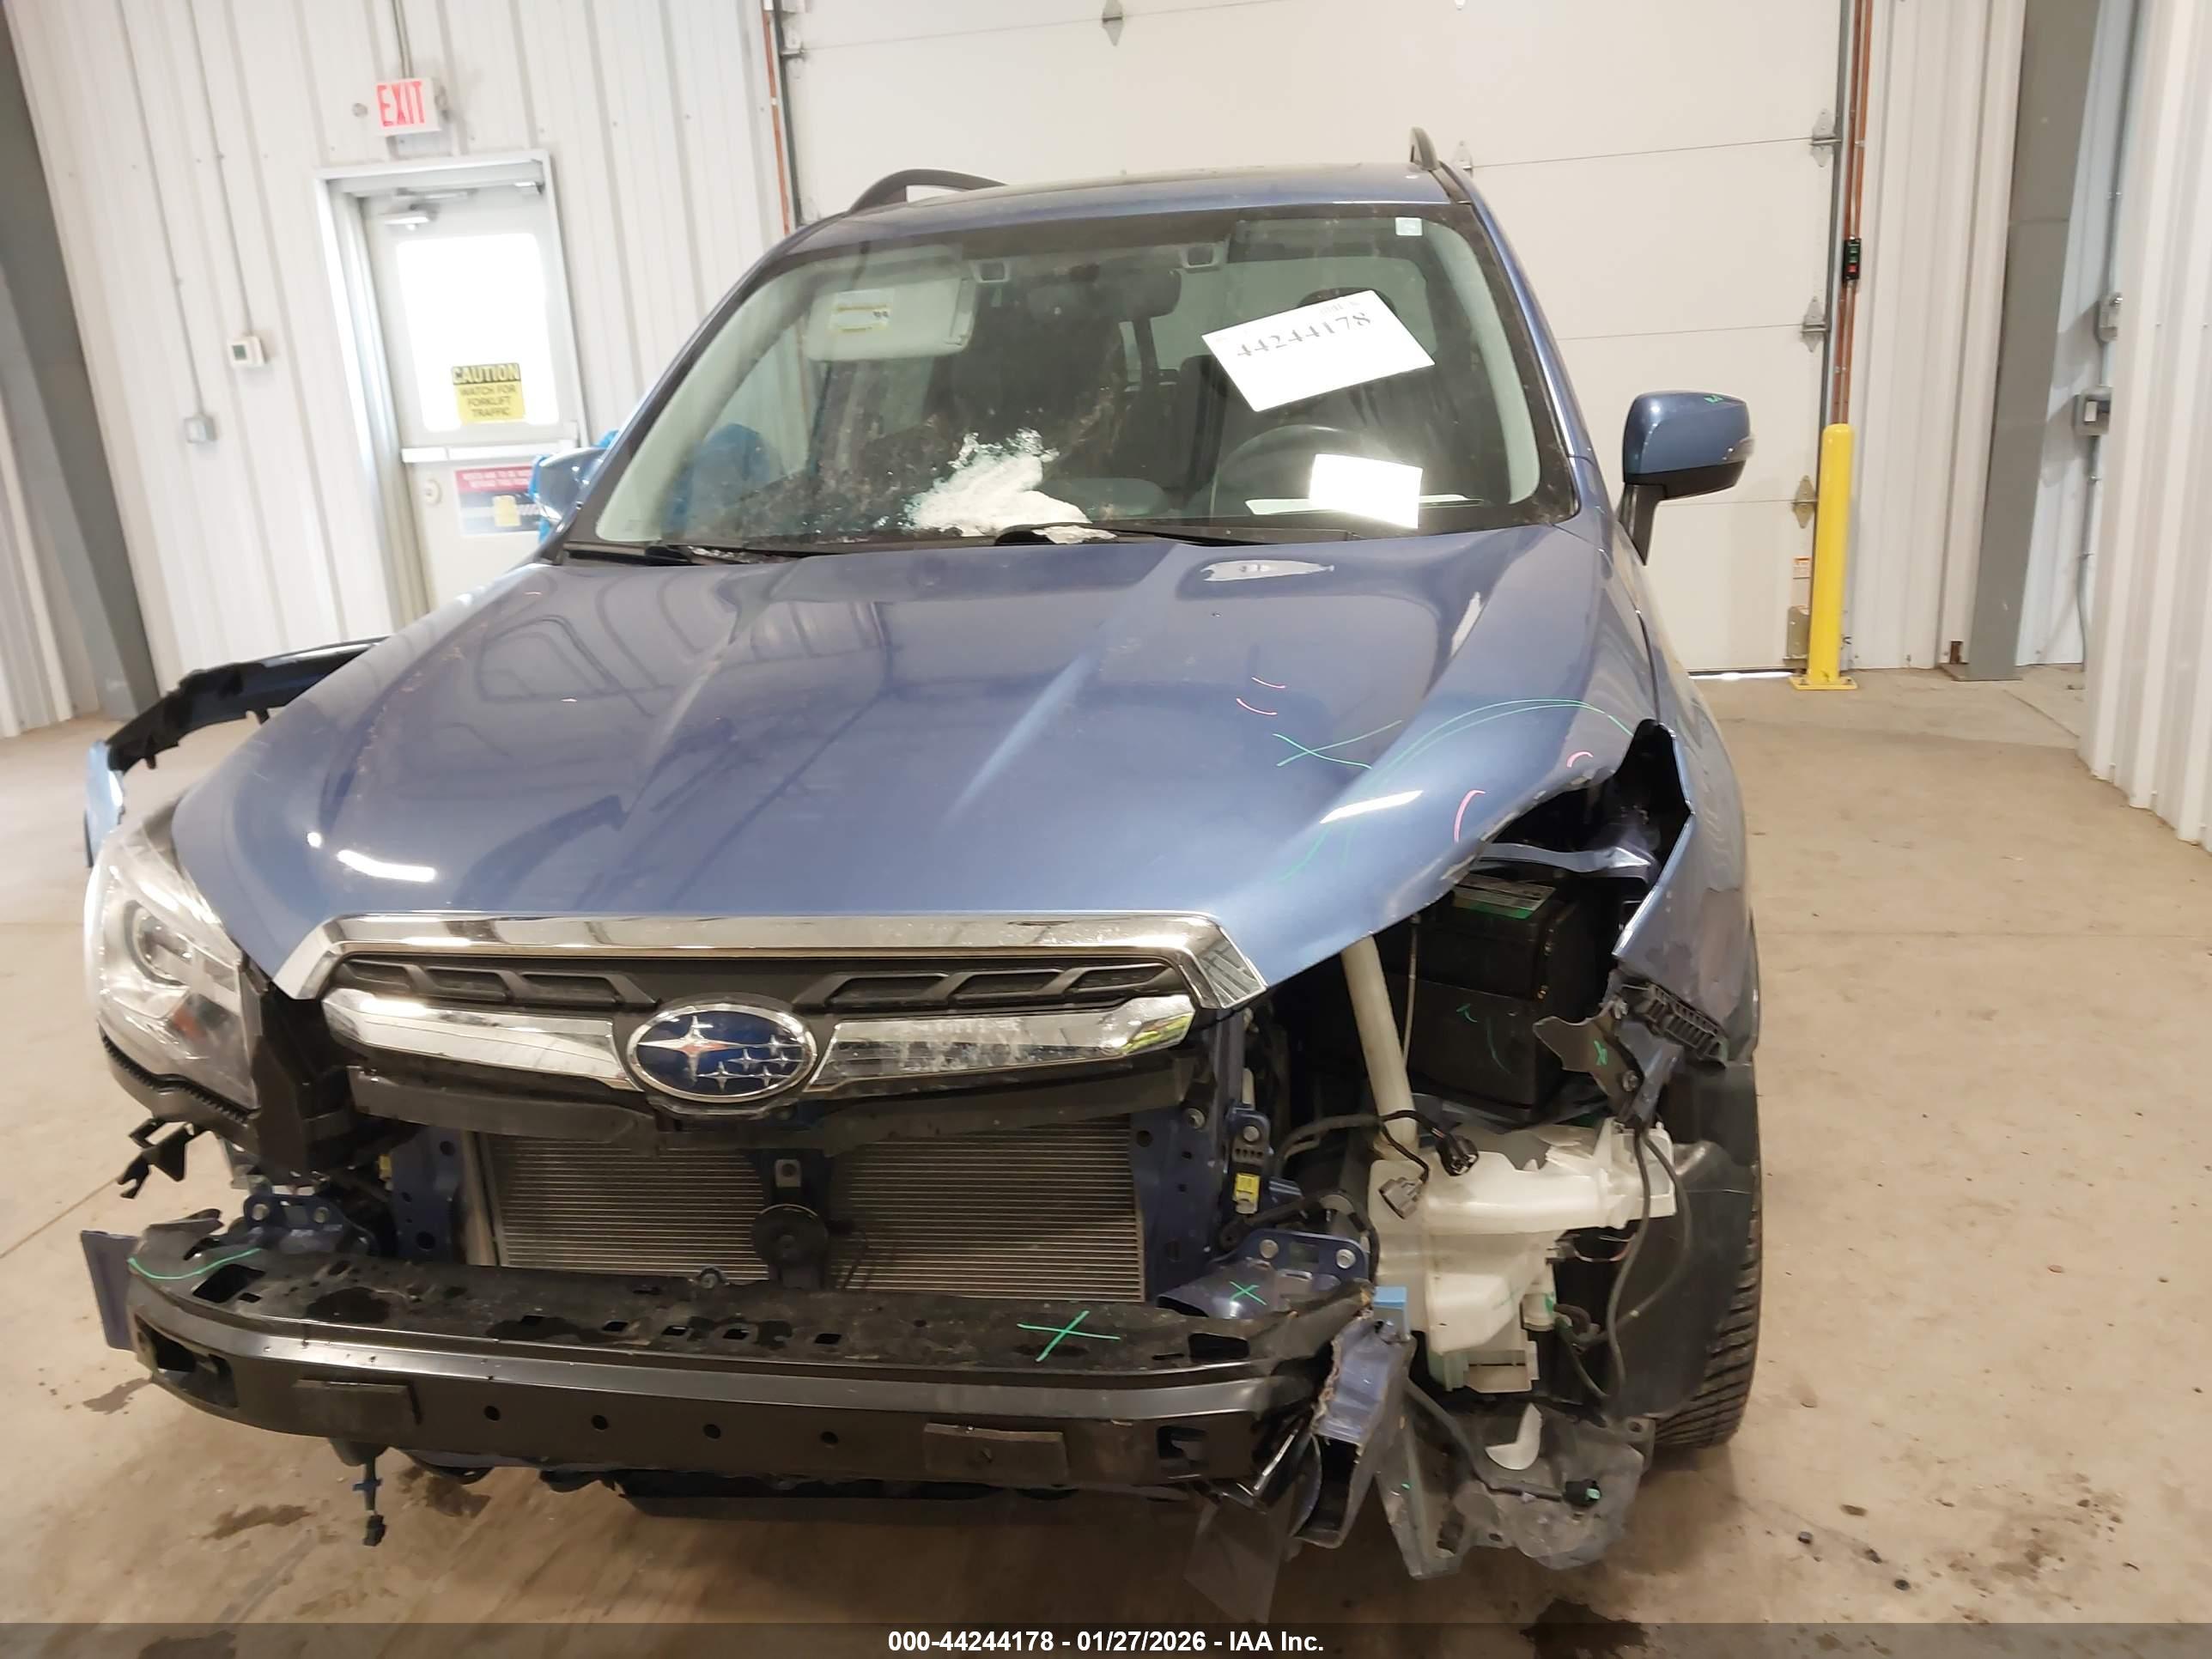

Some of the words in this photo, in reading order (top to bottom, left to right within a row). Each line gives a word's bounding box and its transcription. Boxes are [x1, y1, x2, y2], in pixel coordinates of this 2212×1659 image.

[376, 81, 426, 127] EXIT
[1237, 311, 1372, 357] 44244178
[453, 364, 520, 384] CAUTION
[497, 384, 517, 393] FOR
[467, 396, 512, 407] FORKLIFT
[471, 406, 511, 417] TRAFFIC
